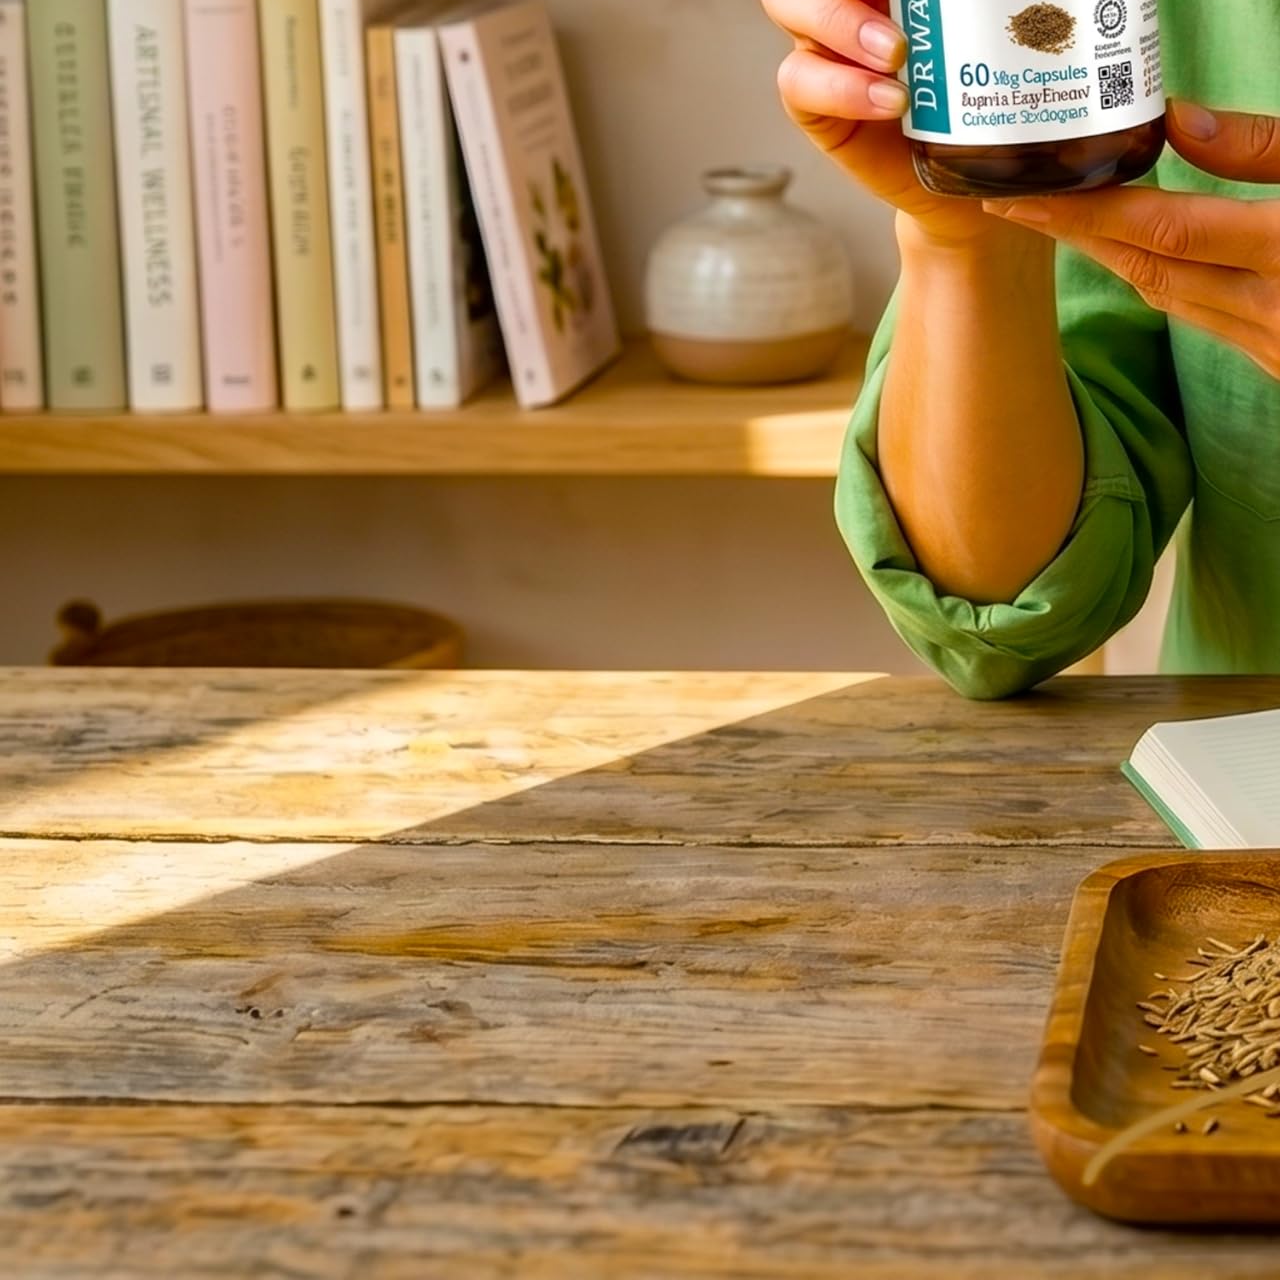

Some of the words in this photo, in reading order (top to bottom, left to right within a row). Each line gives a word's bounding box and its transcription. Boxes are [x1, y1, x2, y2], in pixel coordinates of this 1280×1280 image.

[912, 59, 938, 111] DR
[960, 63, 990, 87] 60
[1022, 65, 1088, 86] Capsules
